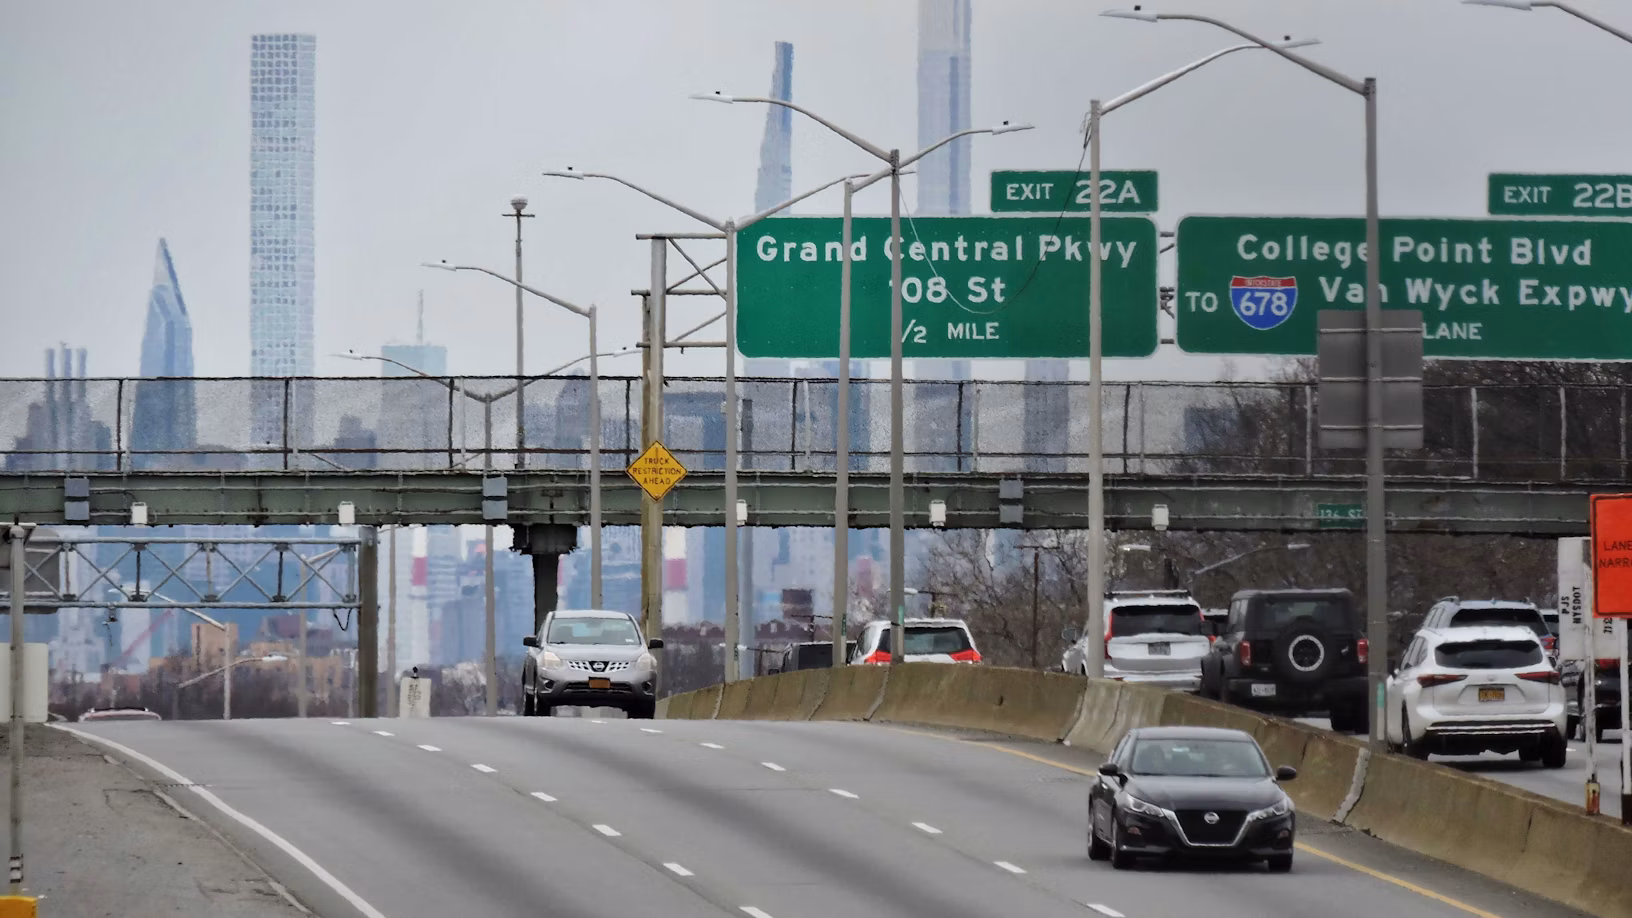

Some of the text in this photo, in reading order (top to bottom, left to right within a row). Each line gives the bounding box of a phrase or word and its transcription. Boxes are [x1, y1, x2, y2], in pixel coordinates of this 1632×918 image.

[1006, 180, 1141, 204] EXIT 22A
[1504, 182, 1632, 208] EXIT 22B
[757, 234, 1137, 268] Grand Central Pkwy
[1238, 233, 1592, 269] College Point Blvd
[889, 276, 1006, 303] 08 St
[1405, 278, 1500, 311] Wyck
[1519, 279, 1632, 313] Expwy
[1186, 291, 1288, 316] TO 678
[947, 322, 1000, 340] MILE
[1421, 322, 1483, 340] LANE
[632, 467, 682, 475] RESTRICTION
[644, 457, 670, 465] TRUCK
[643, 477, 671, 485] AHEAD
[1598, 557, 1632, 568] NARR
[1561, 595, 1570, 615] PJS
[1572, 586, 1582, 624] NYSDOT
